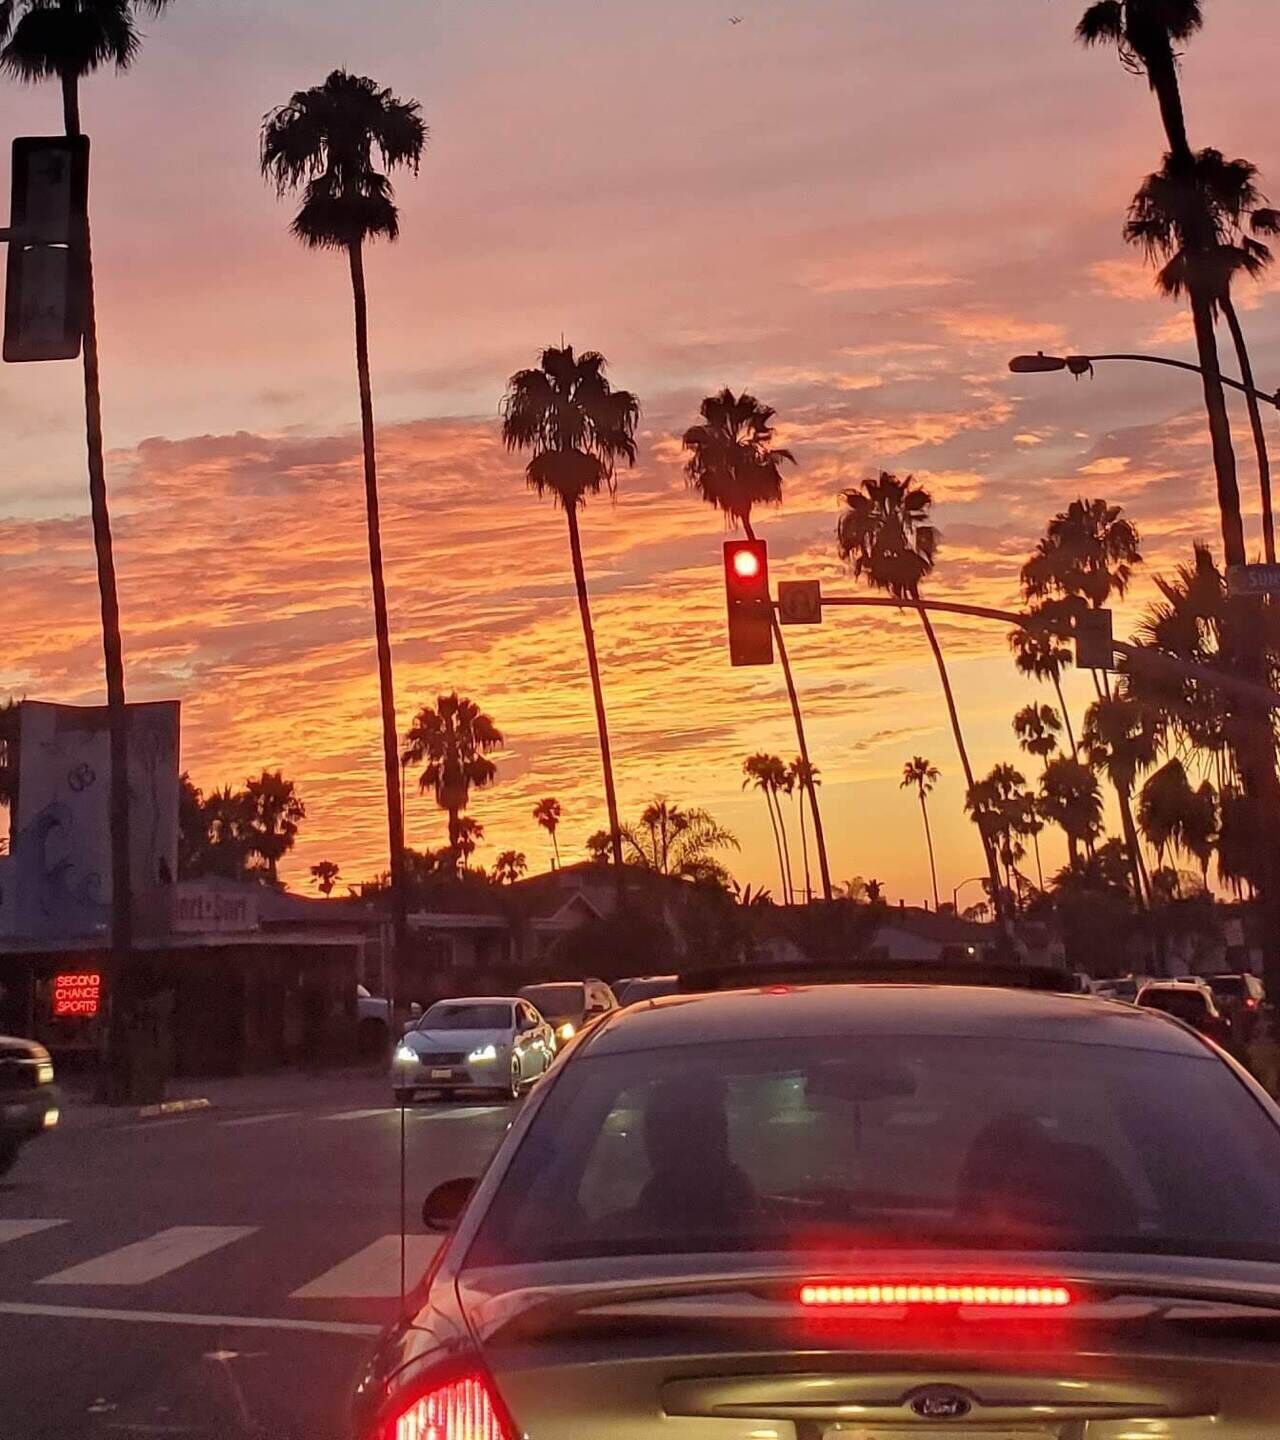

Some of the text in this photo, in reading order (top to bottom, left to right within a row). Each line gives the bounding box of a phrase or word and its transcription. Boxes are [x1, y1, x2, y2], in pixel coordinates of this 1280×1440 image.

[56, 975, 100, 987] SECOND
[55, 987, 100, 1000] CHANCE
[56, 1000, 97, 1012] SPORTS
